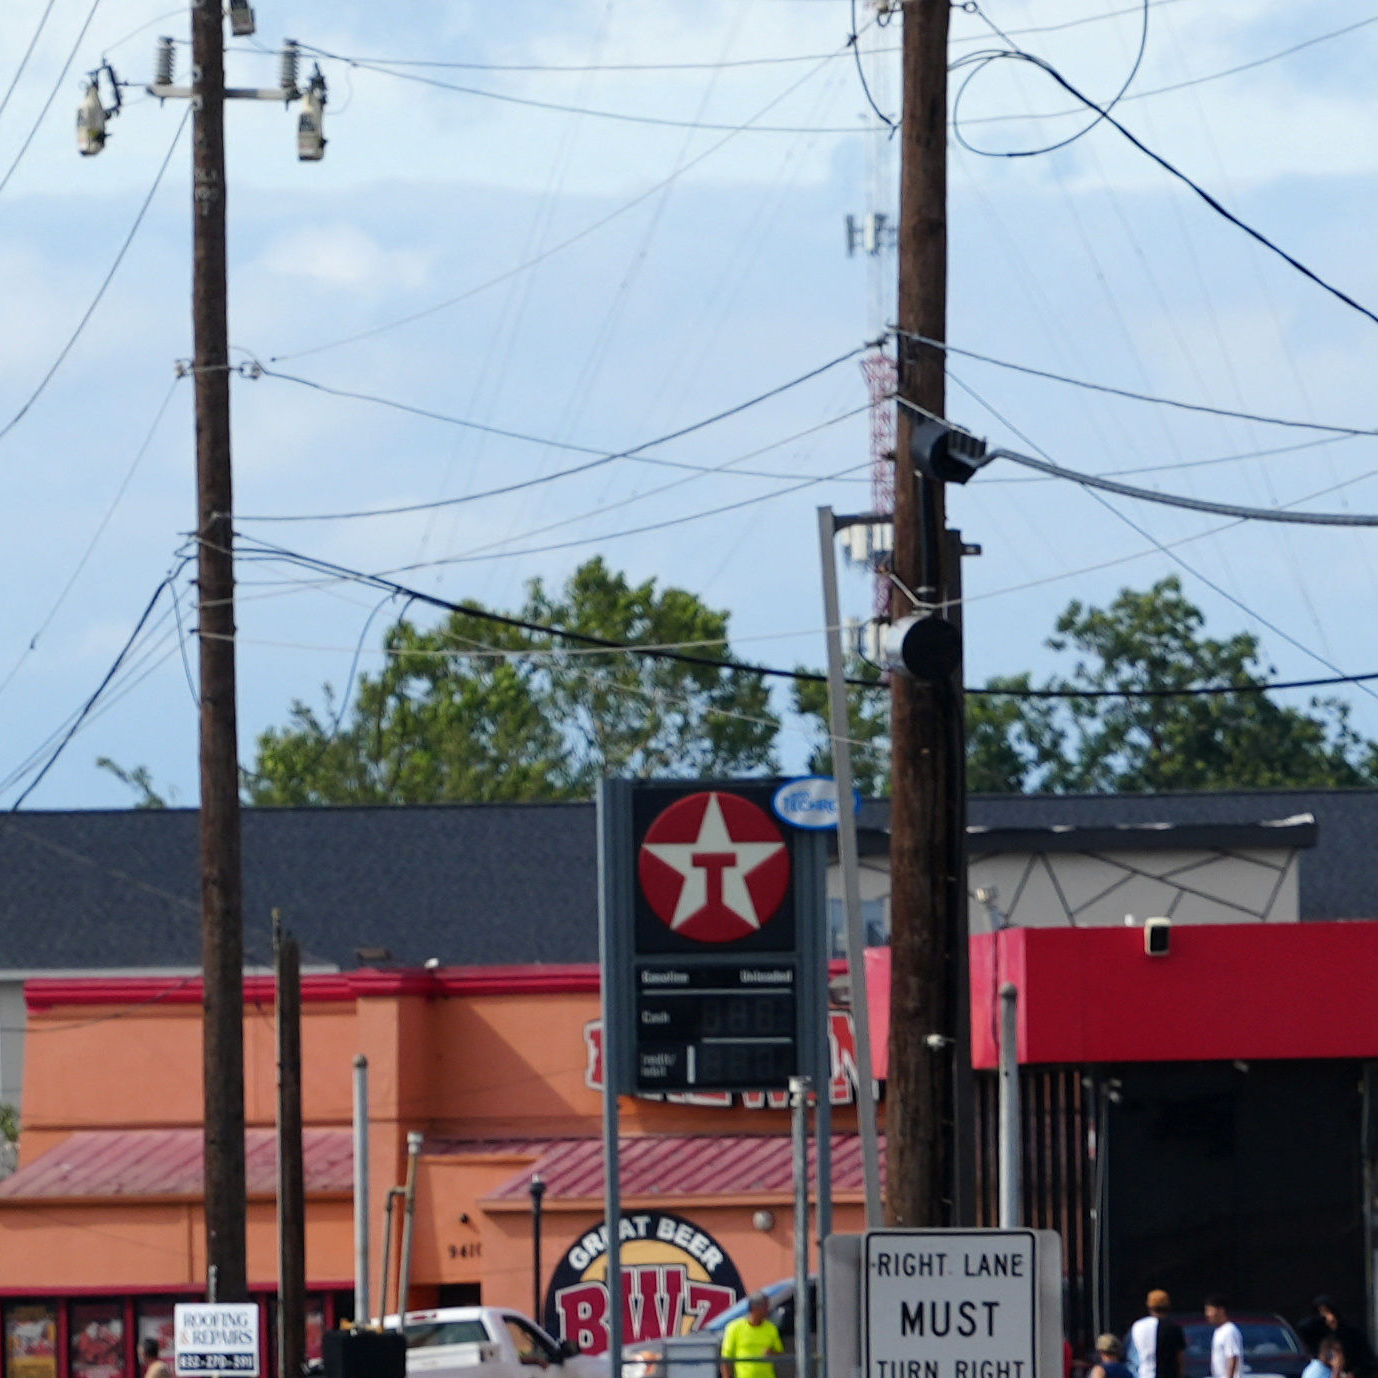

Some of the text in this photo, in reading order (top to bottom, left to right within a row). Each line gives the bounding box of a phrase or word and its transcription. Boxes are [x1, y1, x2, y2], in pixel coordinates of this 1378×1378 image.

[641, 970, 793, 984] Gasoline Unleaded
[641, 1010, 671, 1024] Cash
[656, 1216, 724, 1272] BEER
[877, 1252, 1024, 1277] RIGHT LANE
[183, 1312, 248, 1327] ROOFING
[900, 1301, 1000, 1337] MUST
[192, 1329, 253, 1345] REPAIRS
